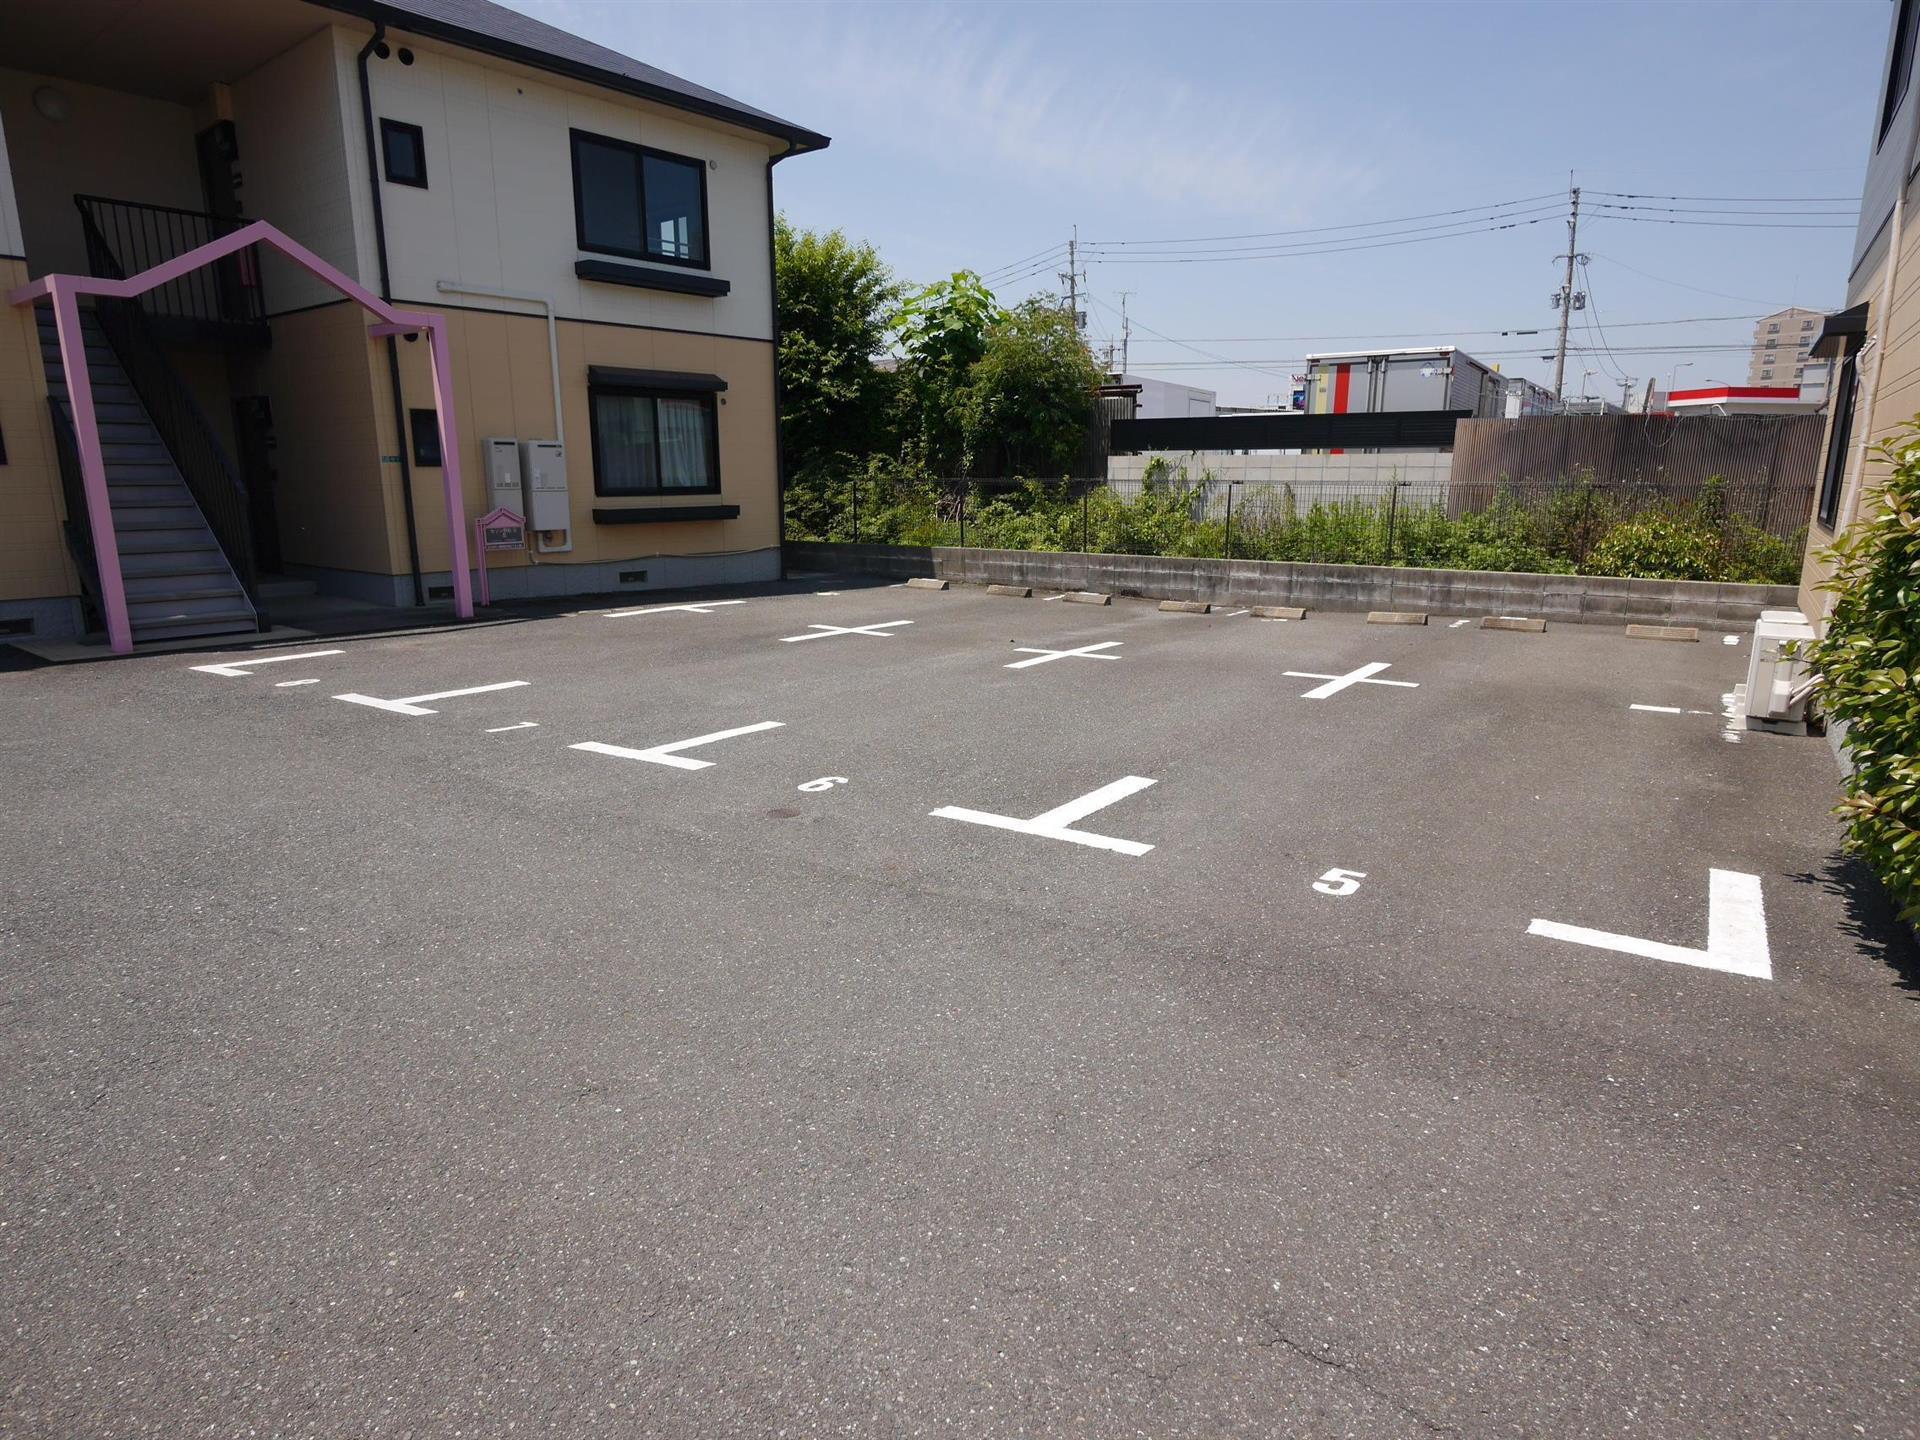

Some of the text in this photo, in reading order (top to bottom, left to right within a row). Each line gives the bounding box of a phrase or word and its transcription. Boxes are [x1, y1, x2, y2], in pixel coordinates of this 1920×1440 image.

[275, 678, 321, 687] 8
[485, 721, 540, 733] 7
[797, 776, 849, 792] 6
[1312, 867, 1368, 895] 5
